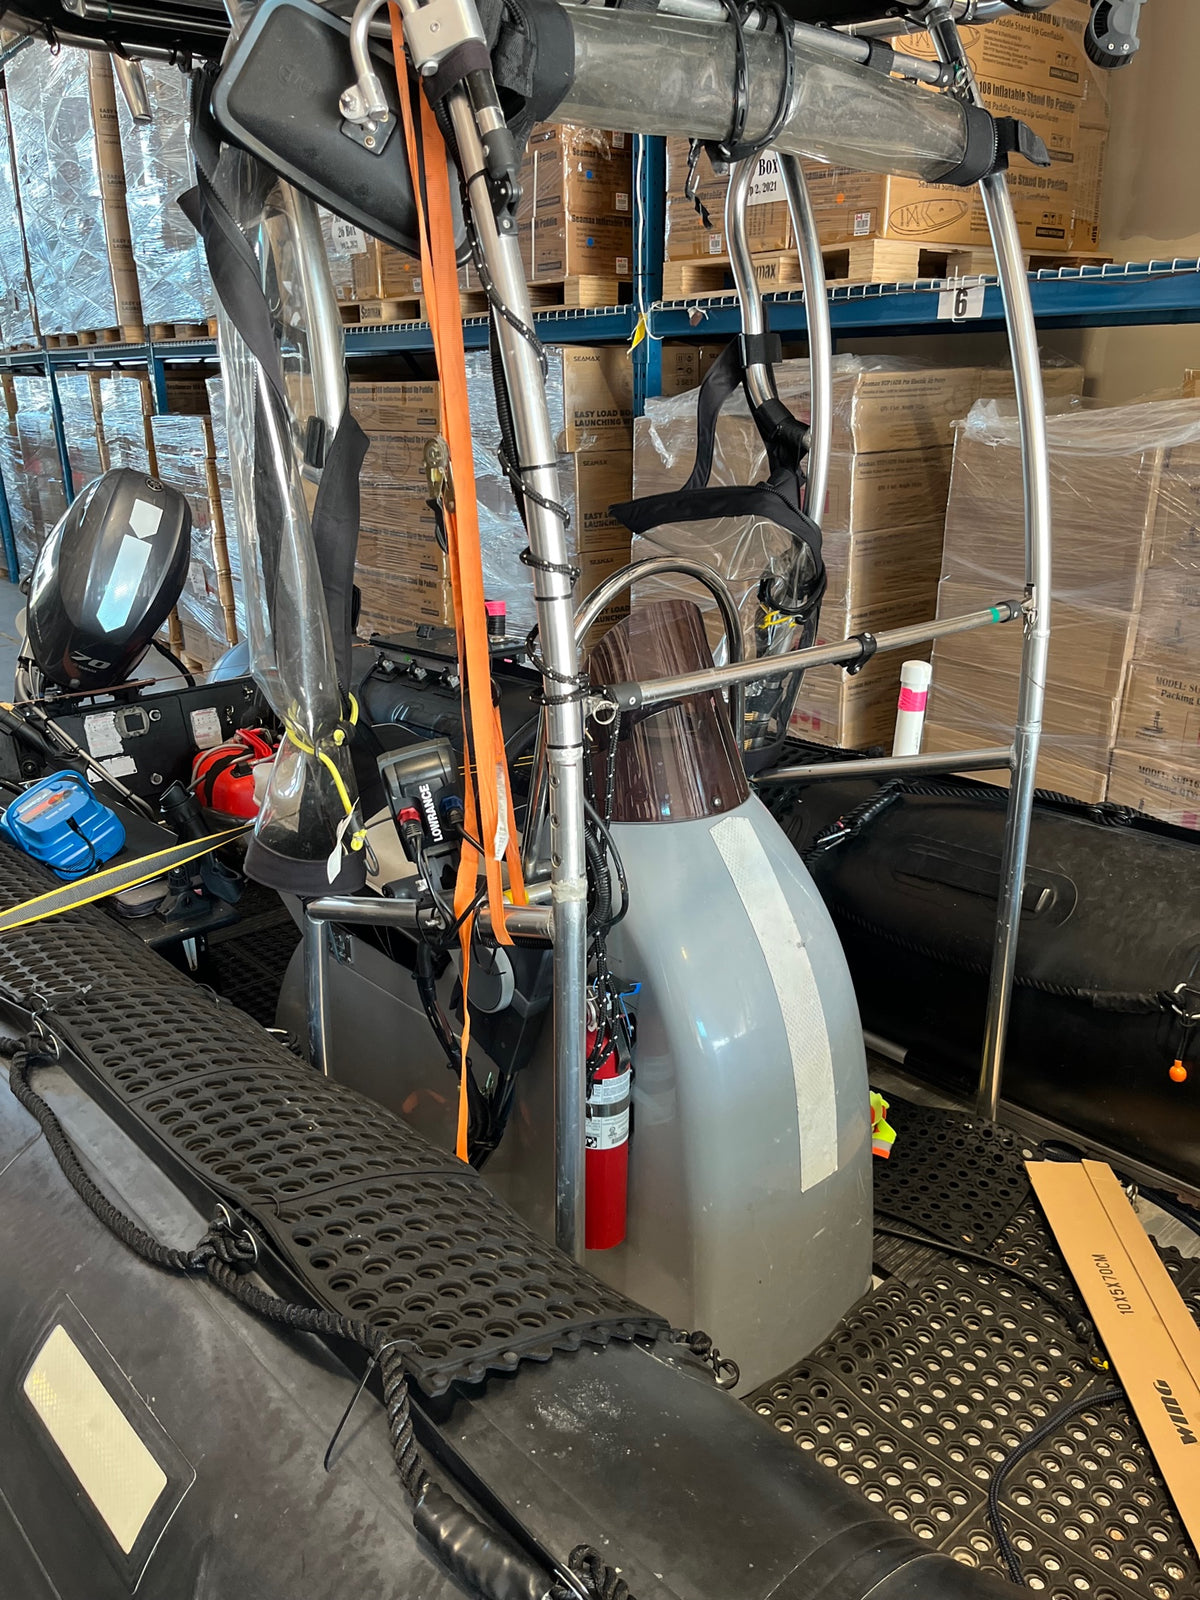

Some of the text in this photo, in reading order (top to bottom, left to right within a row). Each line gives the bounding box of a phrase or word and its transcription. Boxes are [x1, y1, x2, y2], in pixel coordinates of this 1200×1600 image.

[1014, 21, 1031, 33] Stand
[992, 84, 1026, 102] Inflatable
[1026, 91, 1046, 106] Stand
[758, 158, 778, 177] Box
[762, 180, 777, 194] 2021
[954, 288, 969, 318] 6
[574, 410, 596, 419] EASY
[596, 409, 618, 418] LOAD
[574, 418, 621, 427] LAUNCHING
[584, 511, 604, 521] EASY
[611, 605, 631, 613] LOAD
[71, 650, 111, 670] 70
[1156, 675, 1187, 692] MODEL:
[1160, 688, 1195, 706] Packing
[419, 783, 444, 843] LOWRANCE
[1091, 1254, 1135, 1315] 10X5X70CM
